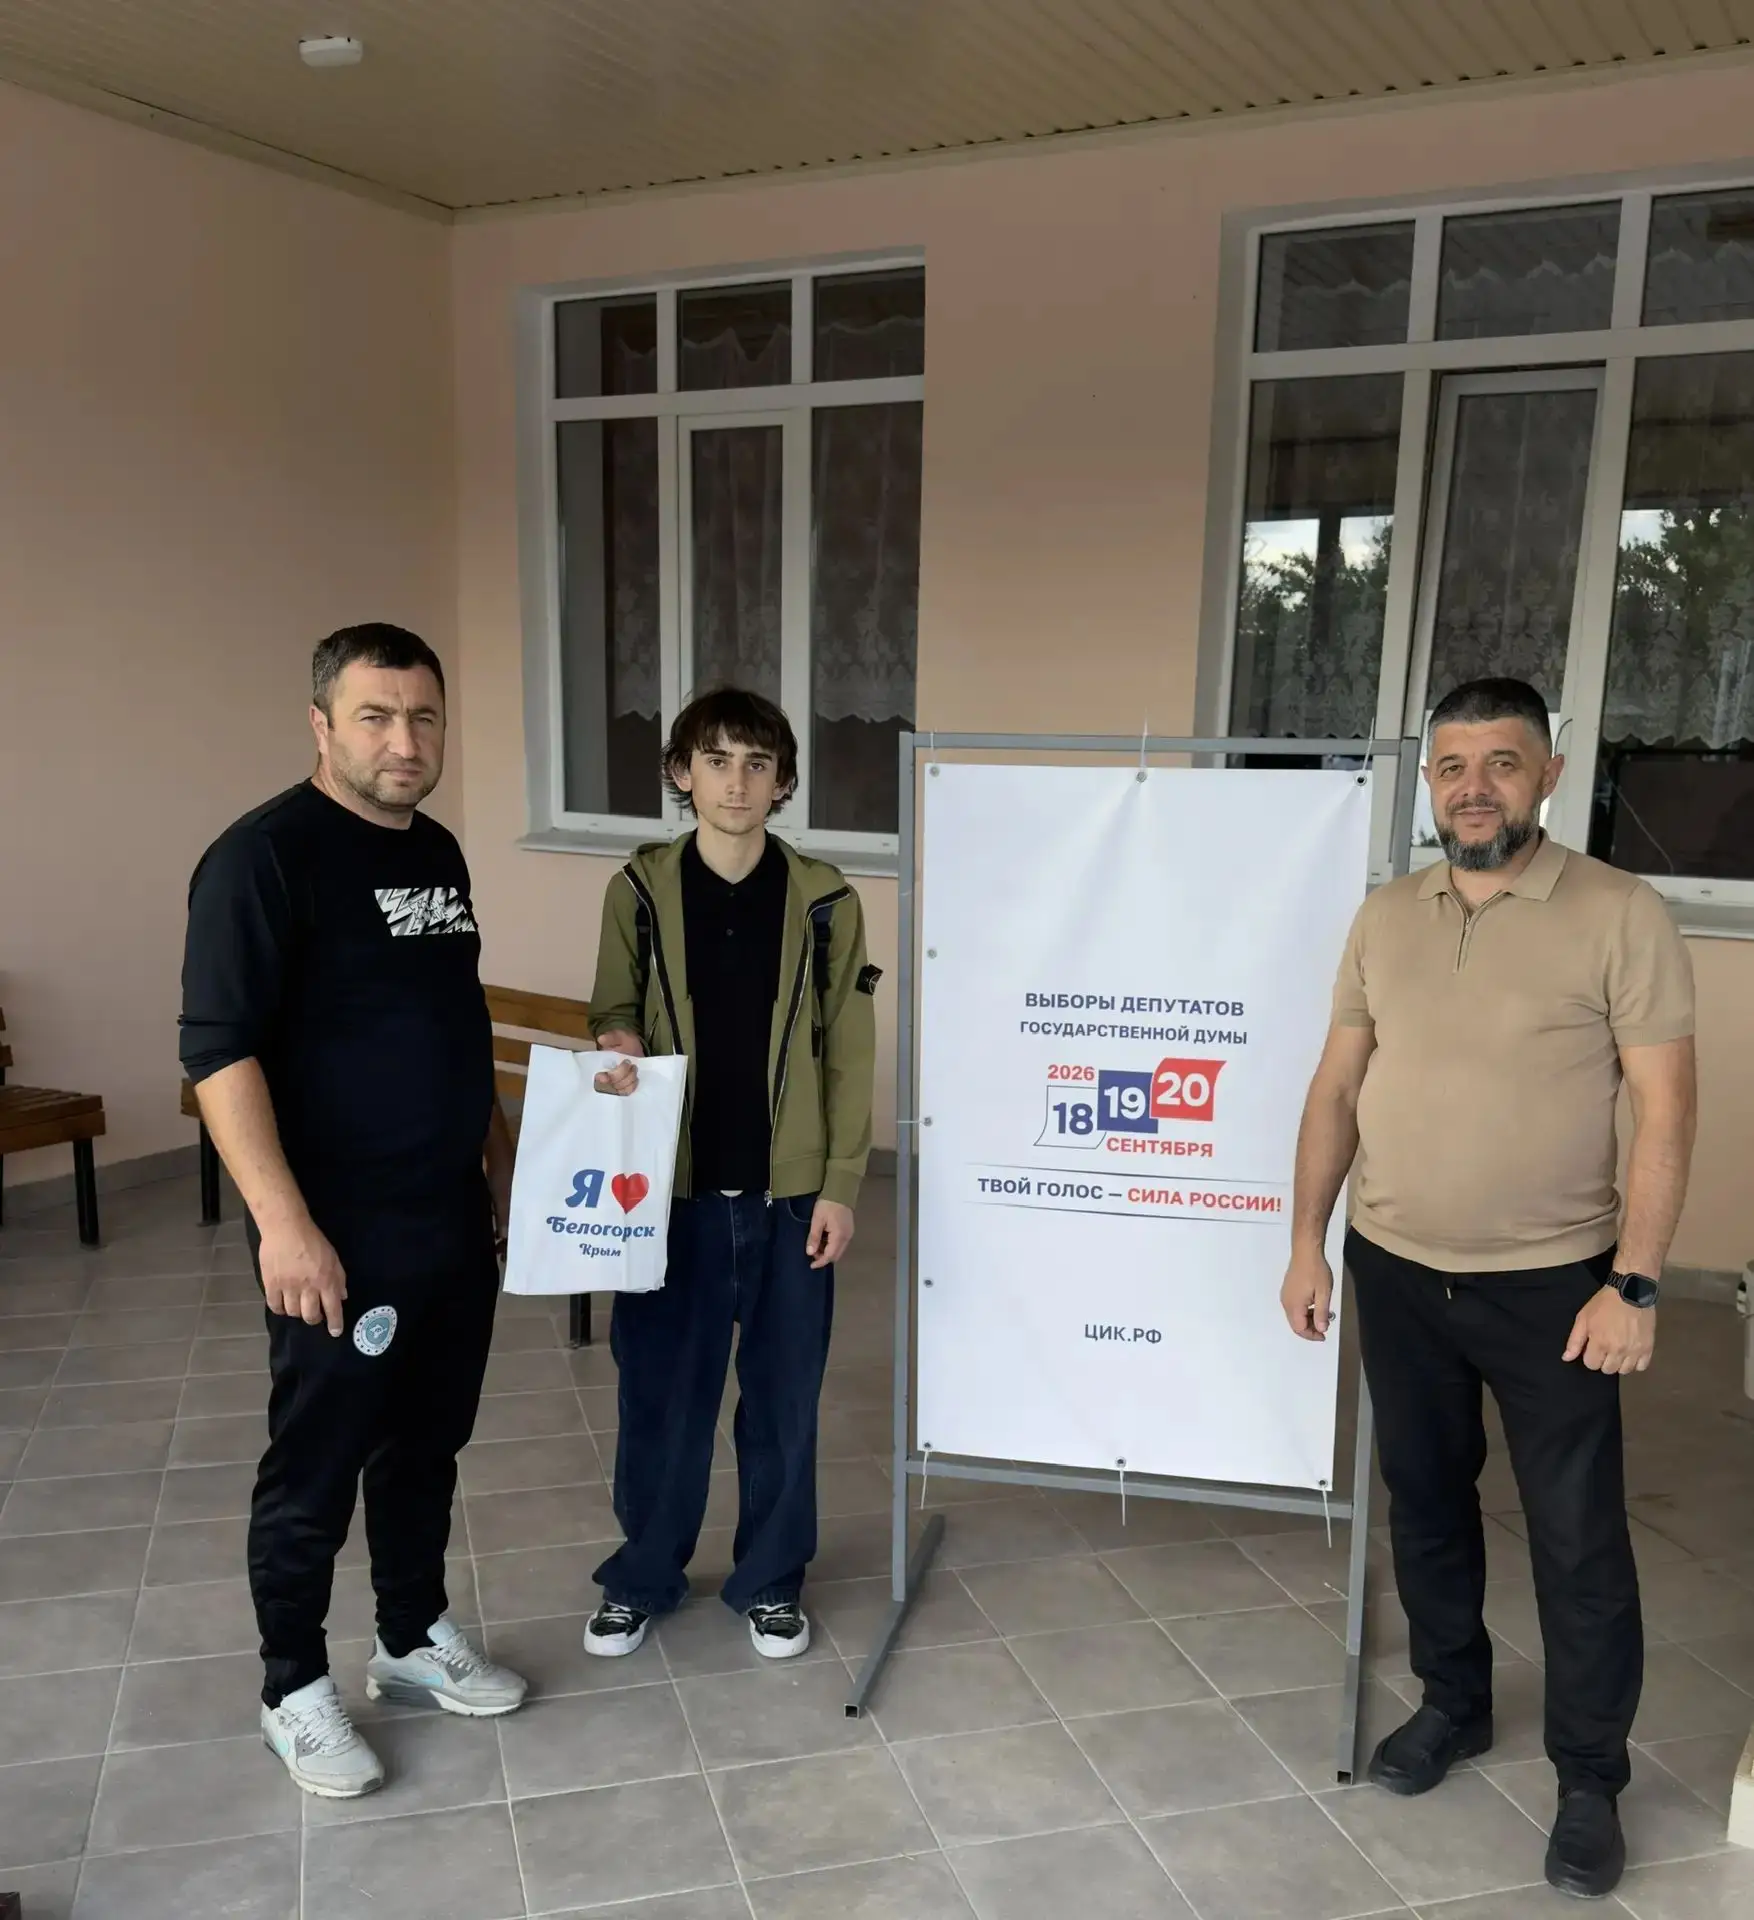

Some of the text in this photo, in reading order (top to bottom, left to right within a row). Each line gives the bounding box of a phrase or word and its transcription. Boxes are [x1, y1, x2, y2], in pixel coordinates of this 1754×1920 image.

[1025, 992, 1245, 1017] ВЫБОРЫ ДЕПУТАТОВ
[1020, 1020, 1248, 1045] ГОСУДАРСТВЕННОЙ ДУМЫ
[1047, 1064, 1095, 1081] 2026
[1052, 1071, 1211, 1136] 18 19 20
[1106, 1136, 1213, 1158] СЕНТЯБРЯ
[564, 1168, 606, 1209] Я
[977, 1176, 1031, 1195] ТВОЙ
[1036, 1181, 1104, 1200] ГОЛОС
[1127, 1187, 1184, 1206] СИЛА
[1189, 1192, 1282, 1213] РОССИИ!
[545, 1215, 656, 1243] Белогорск
[578, 1242, 622, 1259] Крым
[1084, 1323, 1162, 1345] ЦИК.РФ
